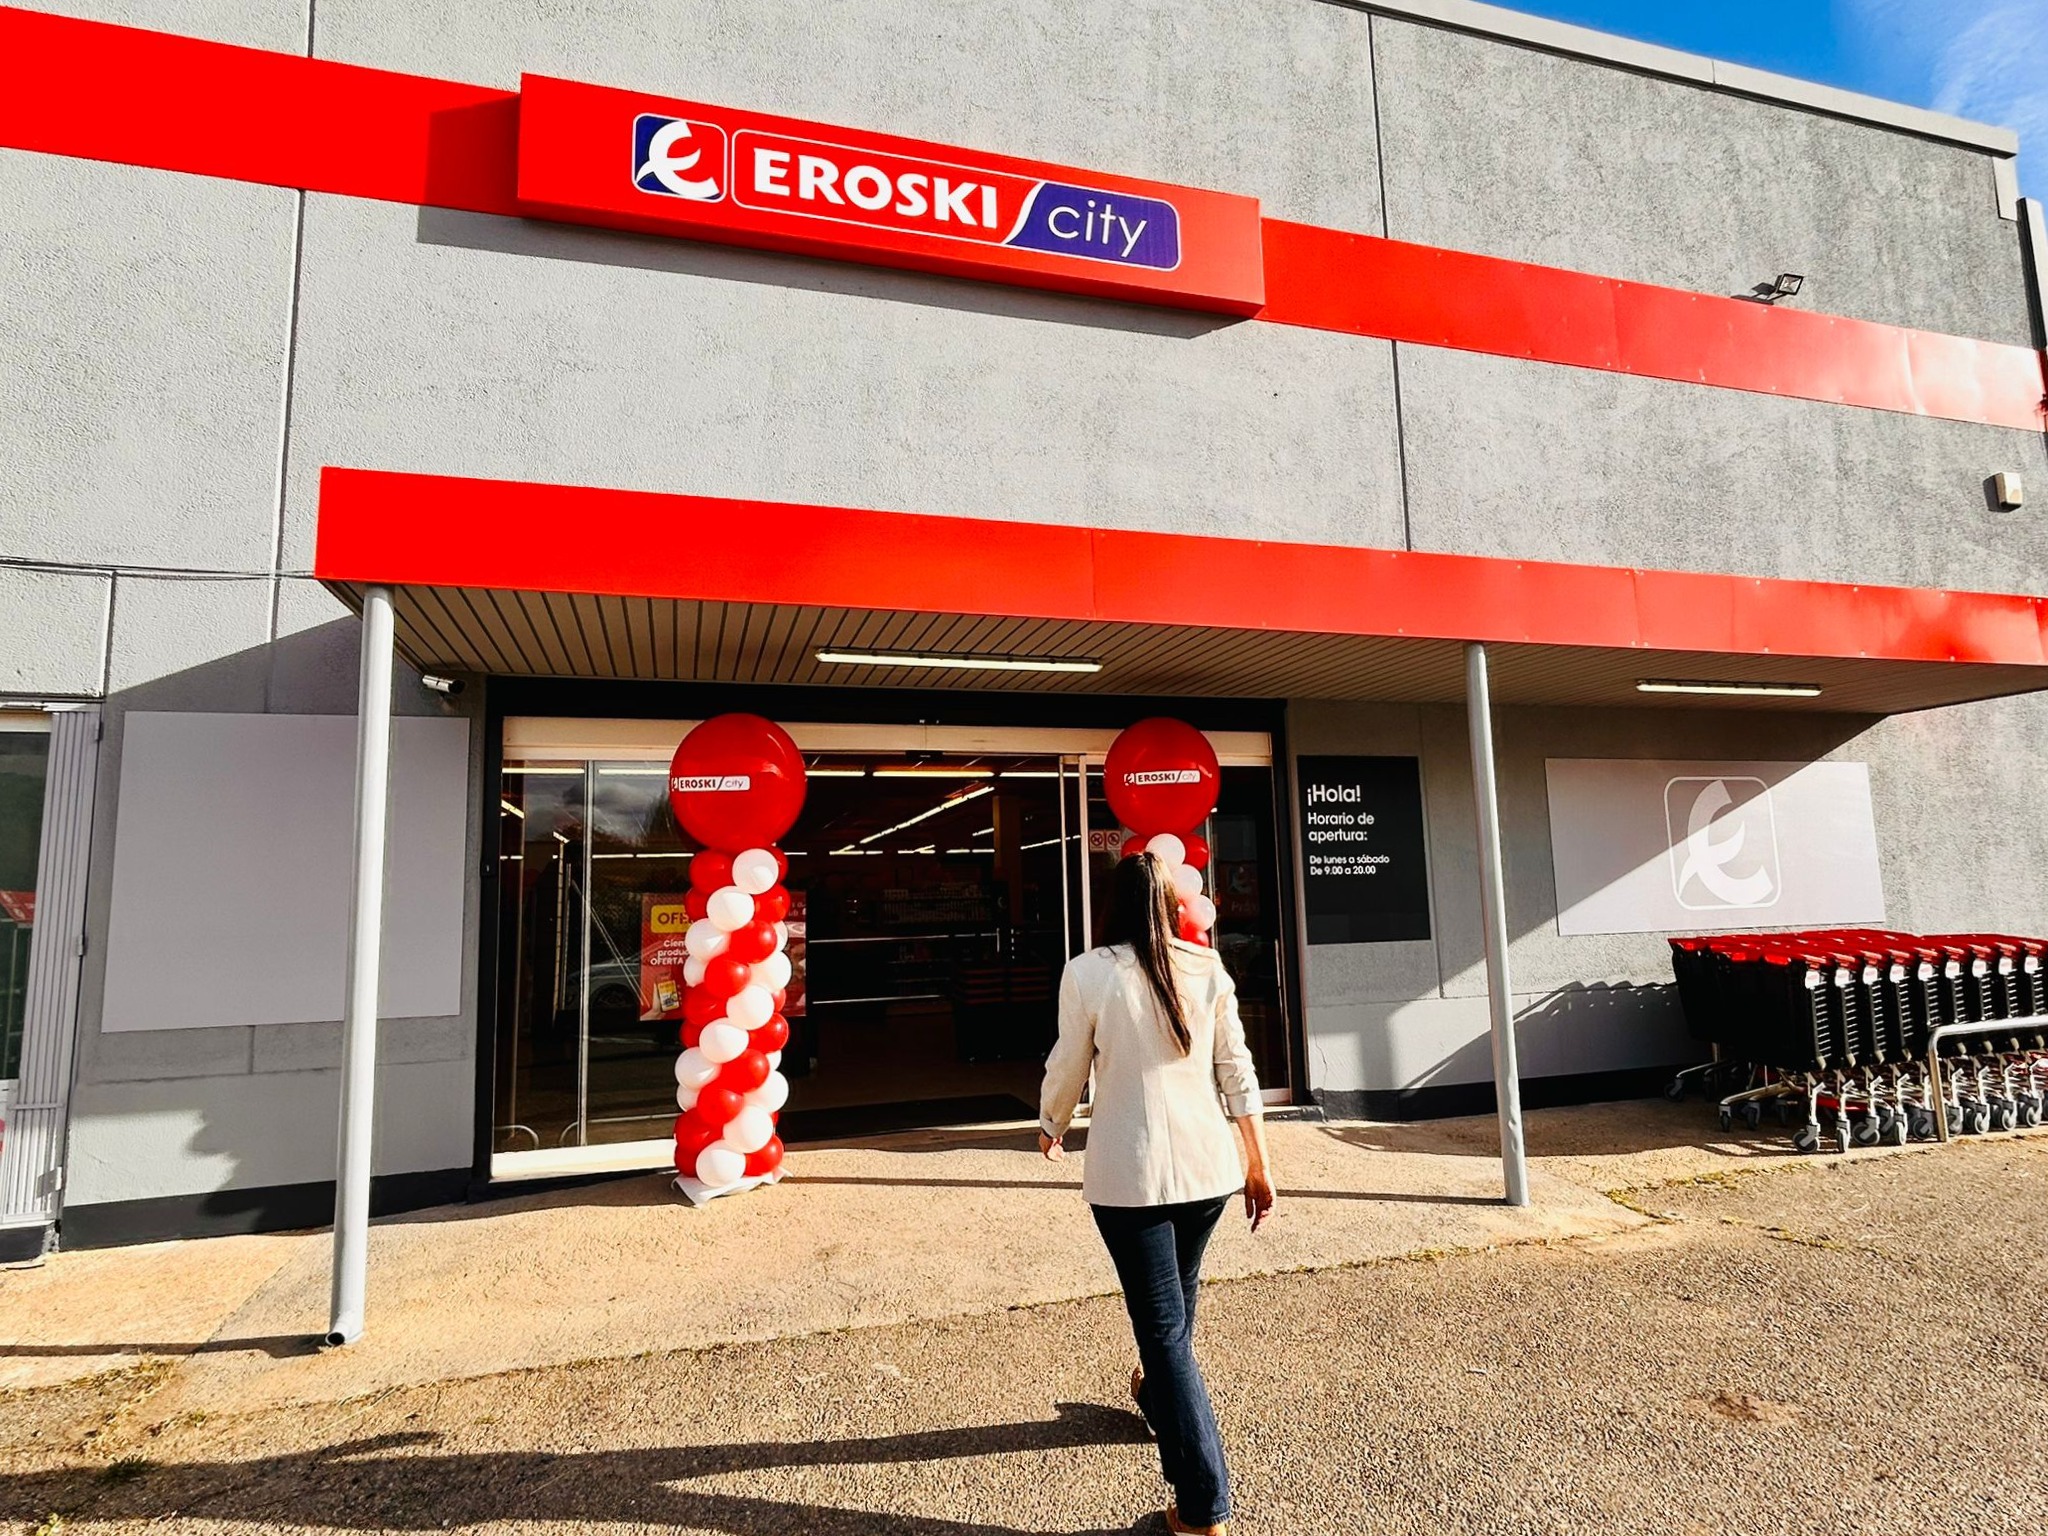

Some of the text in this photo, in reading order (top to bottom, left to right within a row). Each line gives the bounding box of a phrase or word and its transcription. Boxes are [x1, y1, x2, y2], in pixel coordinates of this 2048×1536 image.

[753, 147, 1147, 258] EROSKI city
[1138, 773, 1175, 782] EROSKI
[680, 779, 743, 789] EROSKI city
[1307, 784, 1361, 806] ¡Hola!
[1308, 812, 1375, 825] Horario de
[1308, 829, 1368, 844] apertura:
[1310, 855, 1322, 864] De
[1324, 855, 1347, 864] lunes
[1357, 854, 1390, 864] sábado
[1310, 866, 1322, 875] De
[1324, 866, 1343, 875] 9.00
[1353, 866, 1376, 875] 20.00
[658, 912, 692, 924] OFE
[663, 939, 685, 948] Cien
[650, 957, 684, 966] OFERTA
